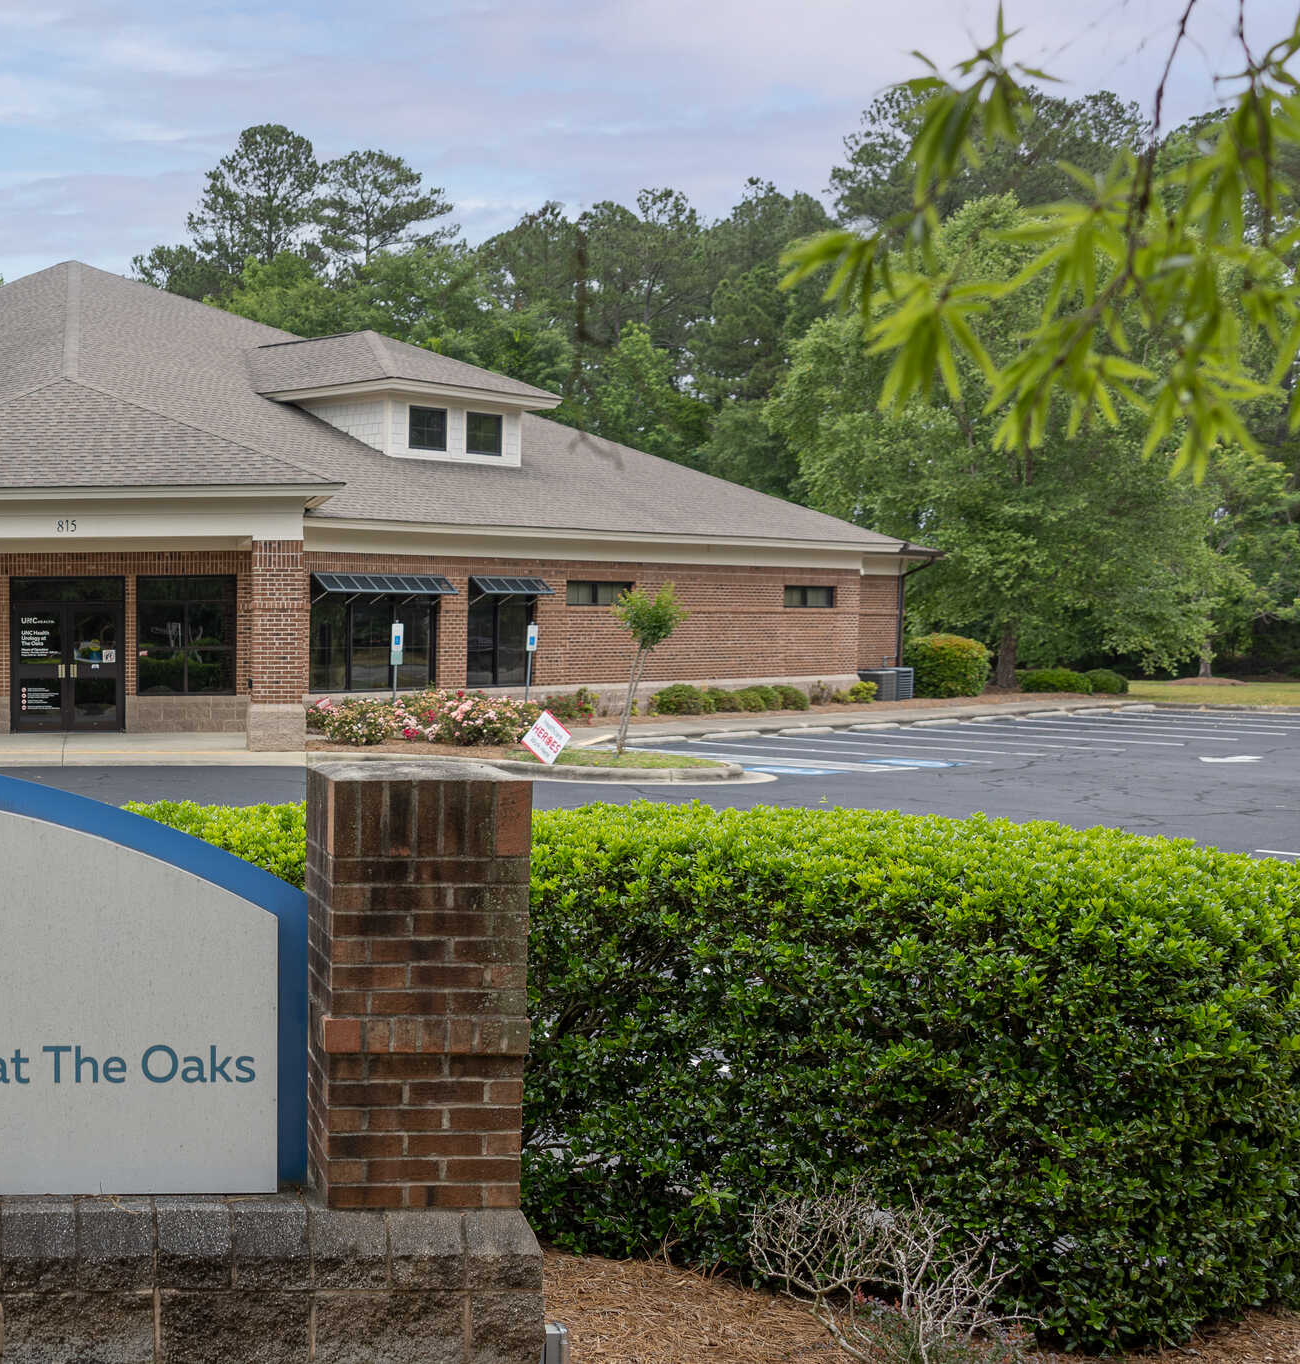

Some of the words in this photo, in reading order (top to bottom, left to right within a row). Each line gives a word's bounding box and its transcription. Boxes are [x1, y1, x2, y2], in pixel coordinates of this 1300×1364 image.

[57, 519, 77, 532] 815
[532, 723, 561, 753] HEROES
[42, 1045, 127, 1083] The
[141, 1044, 256, 1083] Oaks
